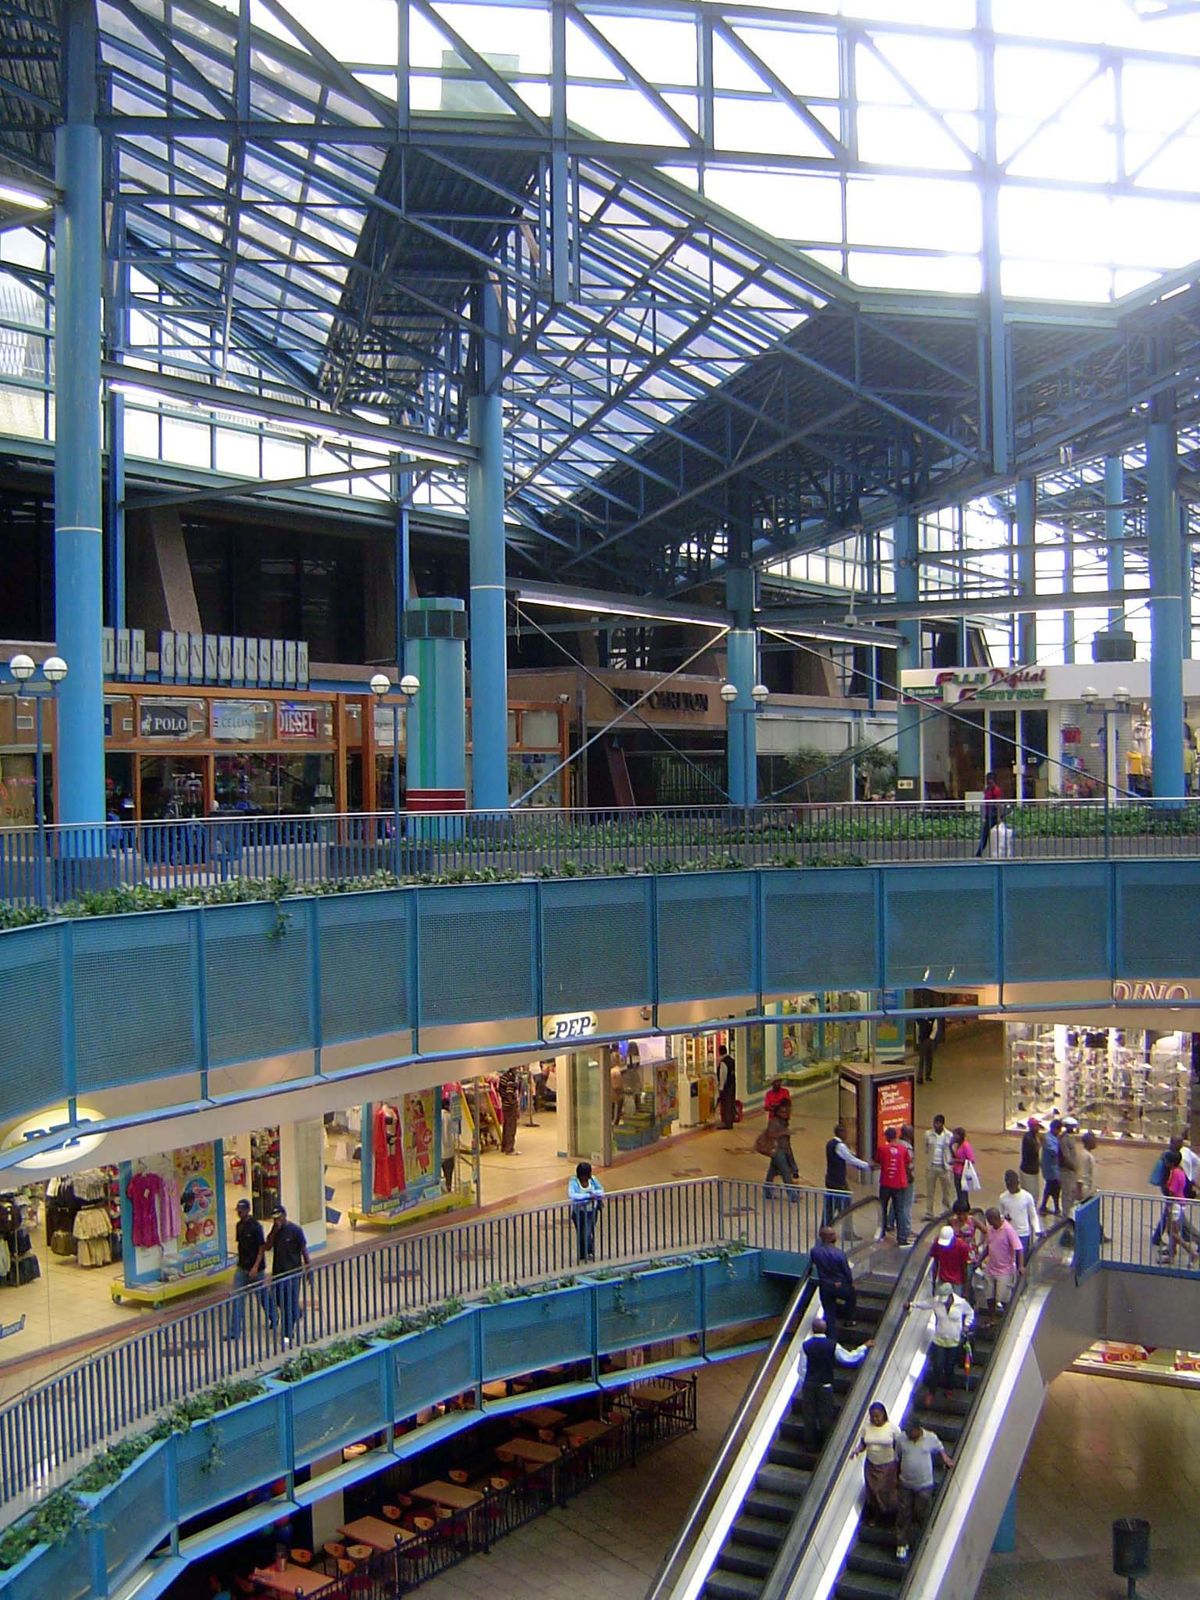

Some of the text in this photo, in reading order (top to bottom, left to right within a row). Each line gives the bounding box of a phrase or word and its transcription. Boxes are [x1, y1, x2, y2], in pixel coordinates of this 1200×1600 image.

[103, 637, 308, 673] THE CONNOISSEUR
[988, 668, 1046, 688] Digital
[958, 688, 1046, 701] CENTRE
[155, 717, 187, 731] POLO
[279, 710, 315, 733] DIESEL
[556, 1016, 591, 1038] PEP
